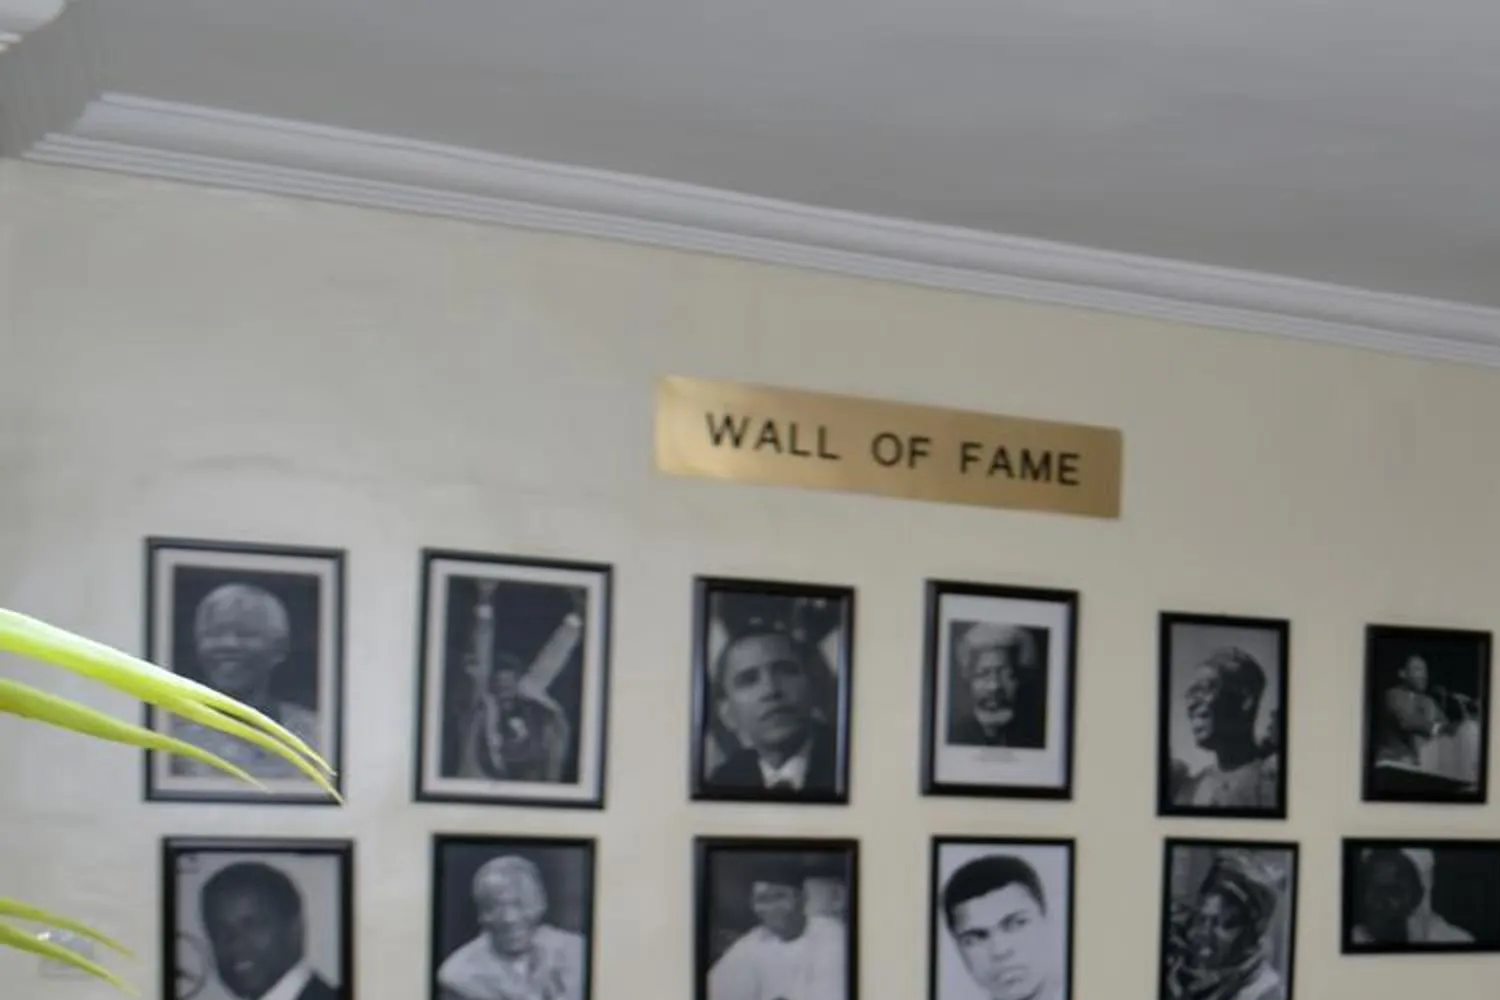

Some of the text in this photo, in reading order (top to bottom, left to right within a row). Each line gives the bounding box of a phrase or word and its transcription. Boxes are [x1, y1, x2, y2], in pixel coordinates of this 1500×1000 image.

[704, 411, 1082, 487] WALL OF FAME
